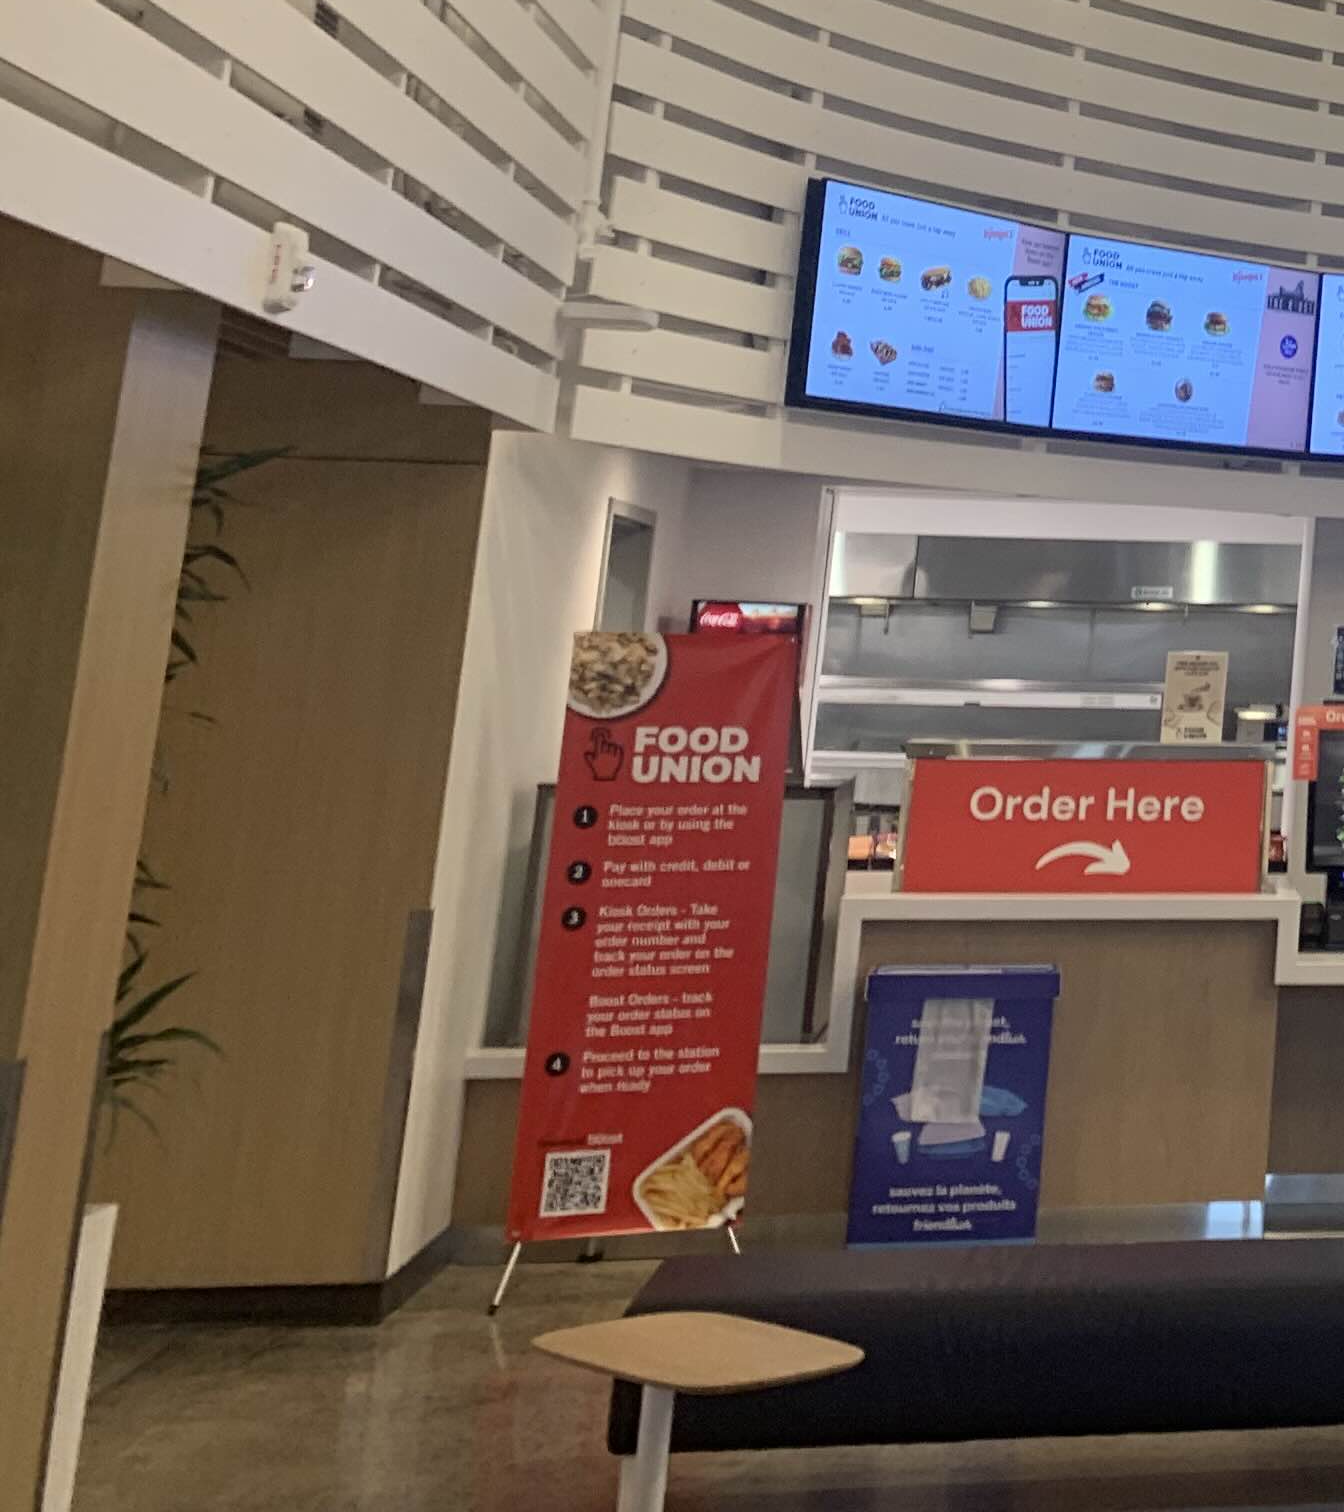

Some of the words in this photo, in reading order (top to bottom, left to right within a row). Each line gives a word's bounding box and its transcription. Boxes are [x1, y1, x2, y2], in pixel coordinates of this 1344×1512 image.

[850, 197, 875, 209] FOOD
[849, 208, 878, 221] UNION
[1094, 248, 1120, 259] FOOD
[1093, 257, 1122, 269] UNION
[1022, 304, 1049, 315] FOOD
[1022, 316, 1052, 328] UNION
[634, 726, 749, 754] FOOD
[631, 755, 762, 784] UNION
[609, 804, 644, 817] Place
[647, 805, 675, 818] your
[677, 804, 710, 816] order
[712, 804, 725, 816] at
[728, 803, 748, 816] the
[969, 785, 1095, 822] Order
[1105, 787, 1206, 822] Here
[643, 821, 656, 831] or
[660, 819, 675, 833] by
[678, 819, 711, 832] using
[714, 818, 735, 830] the
[649, 835, 673, 848] app
[603, 861, 627, 875] Pay
[630, 860, 657, 873] with
[660, 860, 699, 873] credit,
[703, 859, 735, 872] debit
[738, 861, 751, 871] or
[599, 905, 633, 917] Kiosk
[636, 903, 678, 917] Orders
[690, 903, 719, 916] Take
[596, 922, 625, 935] your
[627, 919, 671, 934] receipt
[674, 918, 701, 931] with
[704, 919, 731, 932] your
[594, 935, 627, 948] order
[632, 934, 679, 947] number
[682, 932, 707, 945] and
[594, 949, 626, 962] track
[629, 950, 657, 963] your
[659, 948, 692, 961] order
[694, 949, 711, 960] on
[713, 947, 735, 960] the
[592, 965, 626, 978] order
[628, 963, 666, 976] status
[669, 963, 710, 976] screen
[589, 994, 624, 1008] Boost
[627, 992, 670, 1006] Orders
[682, 991, 713, 1004] track
[586, 1011, 616, 1025] your
[618, 1008, 651, 1022] order
[654, 1007, 692, 1020] status
[695, 1008, 711, 1018] on
[585, 1025, 606, 1037] the
[649, 1024, 673, 1037] app
[583, 1049, 634, 1063] Proceed
[638, 1048, 650, 1061] to
[654, 1047, 674, 1060] the
[677, 1045, 720, 1059] station
[597, 1064, 624, 1079] pick
[628, 1065, 645, 1079] up
[649, 1064, 675, 1077] your
[678, 1062, 712, 1074] order
[579, 1081, 613, 1094] when
